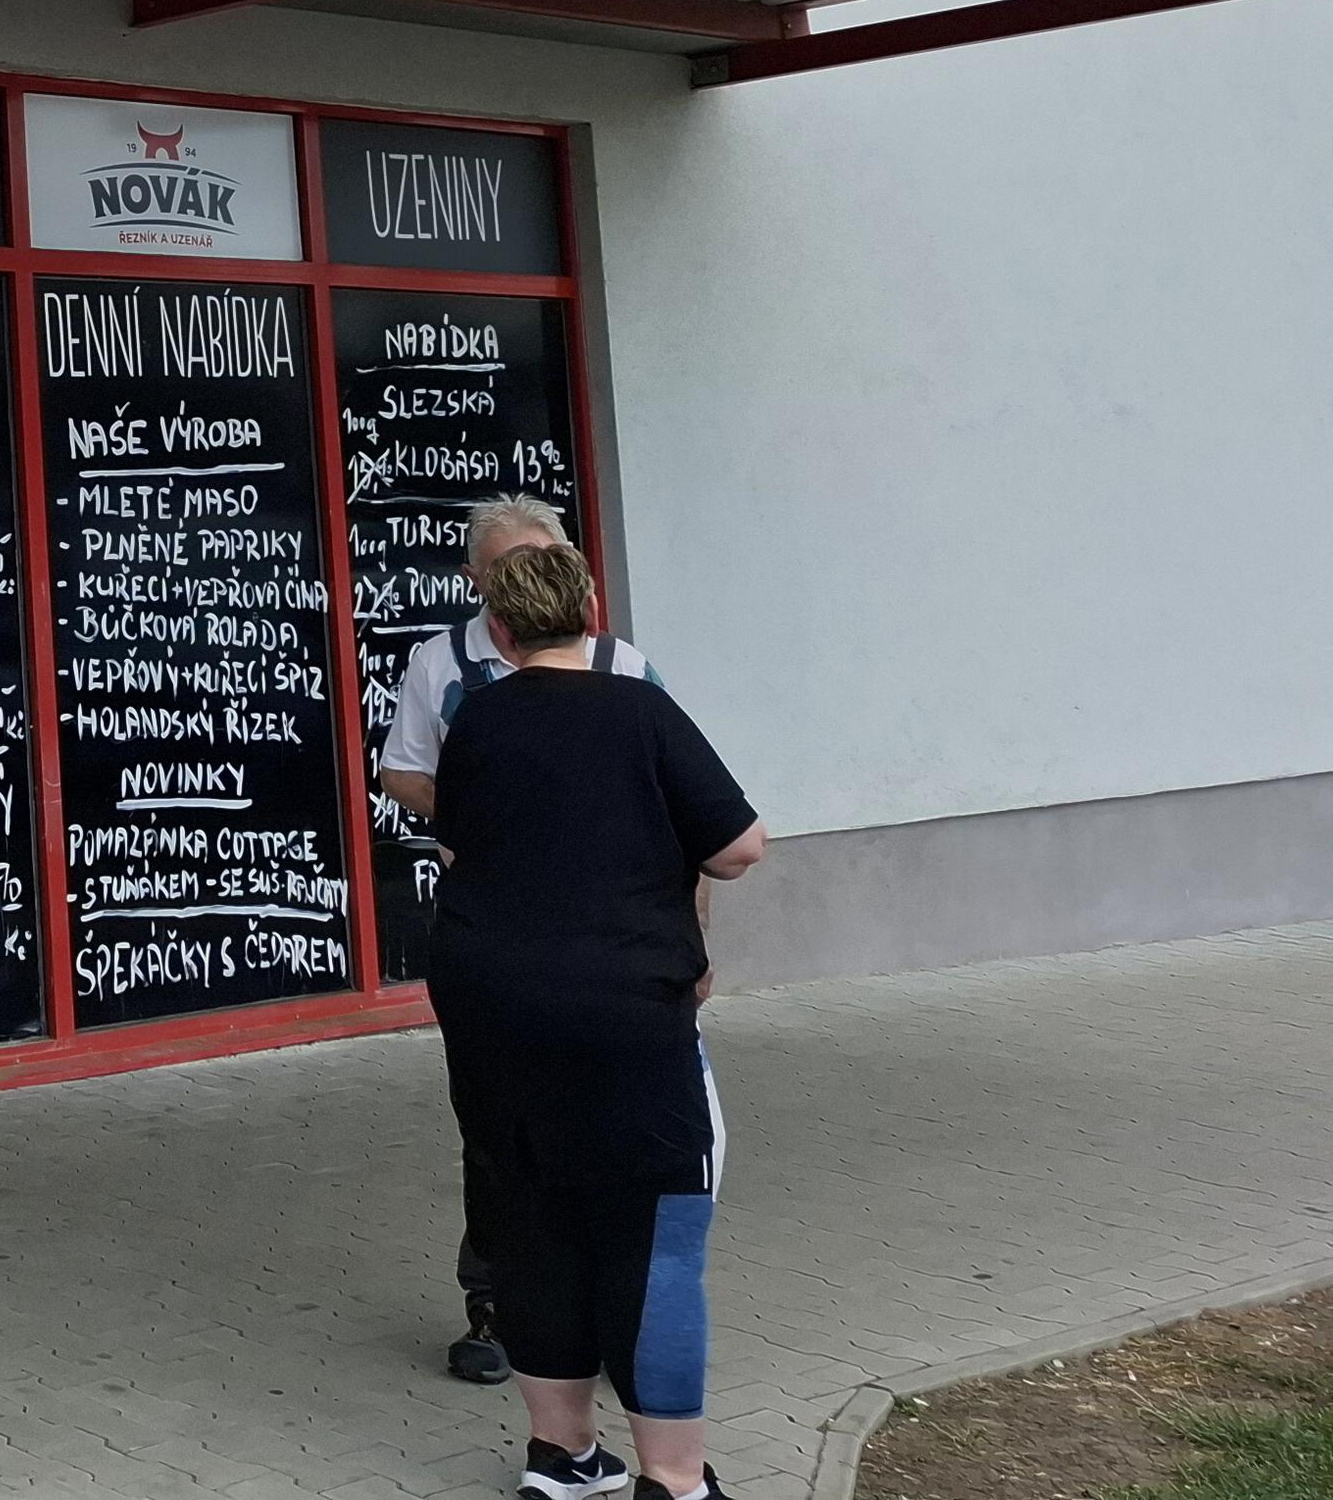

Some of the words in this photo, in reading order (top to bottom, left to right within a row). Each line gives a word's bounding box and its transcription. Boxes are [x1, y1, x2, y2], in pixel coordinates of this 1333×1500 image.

[126, 143, 137, 153] 19
[184, 147, 197, 158] 94
[88, 167, 236, 227] NOVÁK
[365, 150, 502, 242] UZENINY
[118, 230, 158, 245] ŘEZNÍK
[160, 233, 170, 244] A
[170, 234, 214, 249] UZENÁŘ
[43, 285, 144, 379] DENNÍ
[158, 286, 295, 379] NABÍDKA
[384, 313, 500, 361] NABÍDKA
[378, 375, 496, 421] SLEZSKÁ
[67, 401, 150, 460] NAŠE
[159, 400, 263, 453] VÝROBA
[395, 431, 500, 484] KLOBÁSA
[78, 476, 174, 520] MLETÉ
[183, 484, 259, 519] MASO
[81, 517, 189, 566] PLNĚNÉ
[197, 528, 303, 563] PAPRIKY
[284, 563, 329, 614] ČÍNA
[273, 646, 326, 701] ŠPÍZ
[76, 696, 215, 746] HOLANDSKÝ
[222, 696, 303, 745] ŘÍZEK
[120, 761, 245, 798] NOVINKY
[67, 811, 208, 868] POMAZÁNKA
[216, 826, 319, 864] COTTAGE
[81, 877, 97, 910] S
[99, 860, 199, 904] TUŇÁKEM
[285, 862, 349, 918] RAJČATY
[75, 921, 212, 1001] ŠPEKÁČKY
[220, 935, 236, 978] S
[244, 918, 348, 980] ČEDAREM
